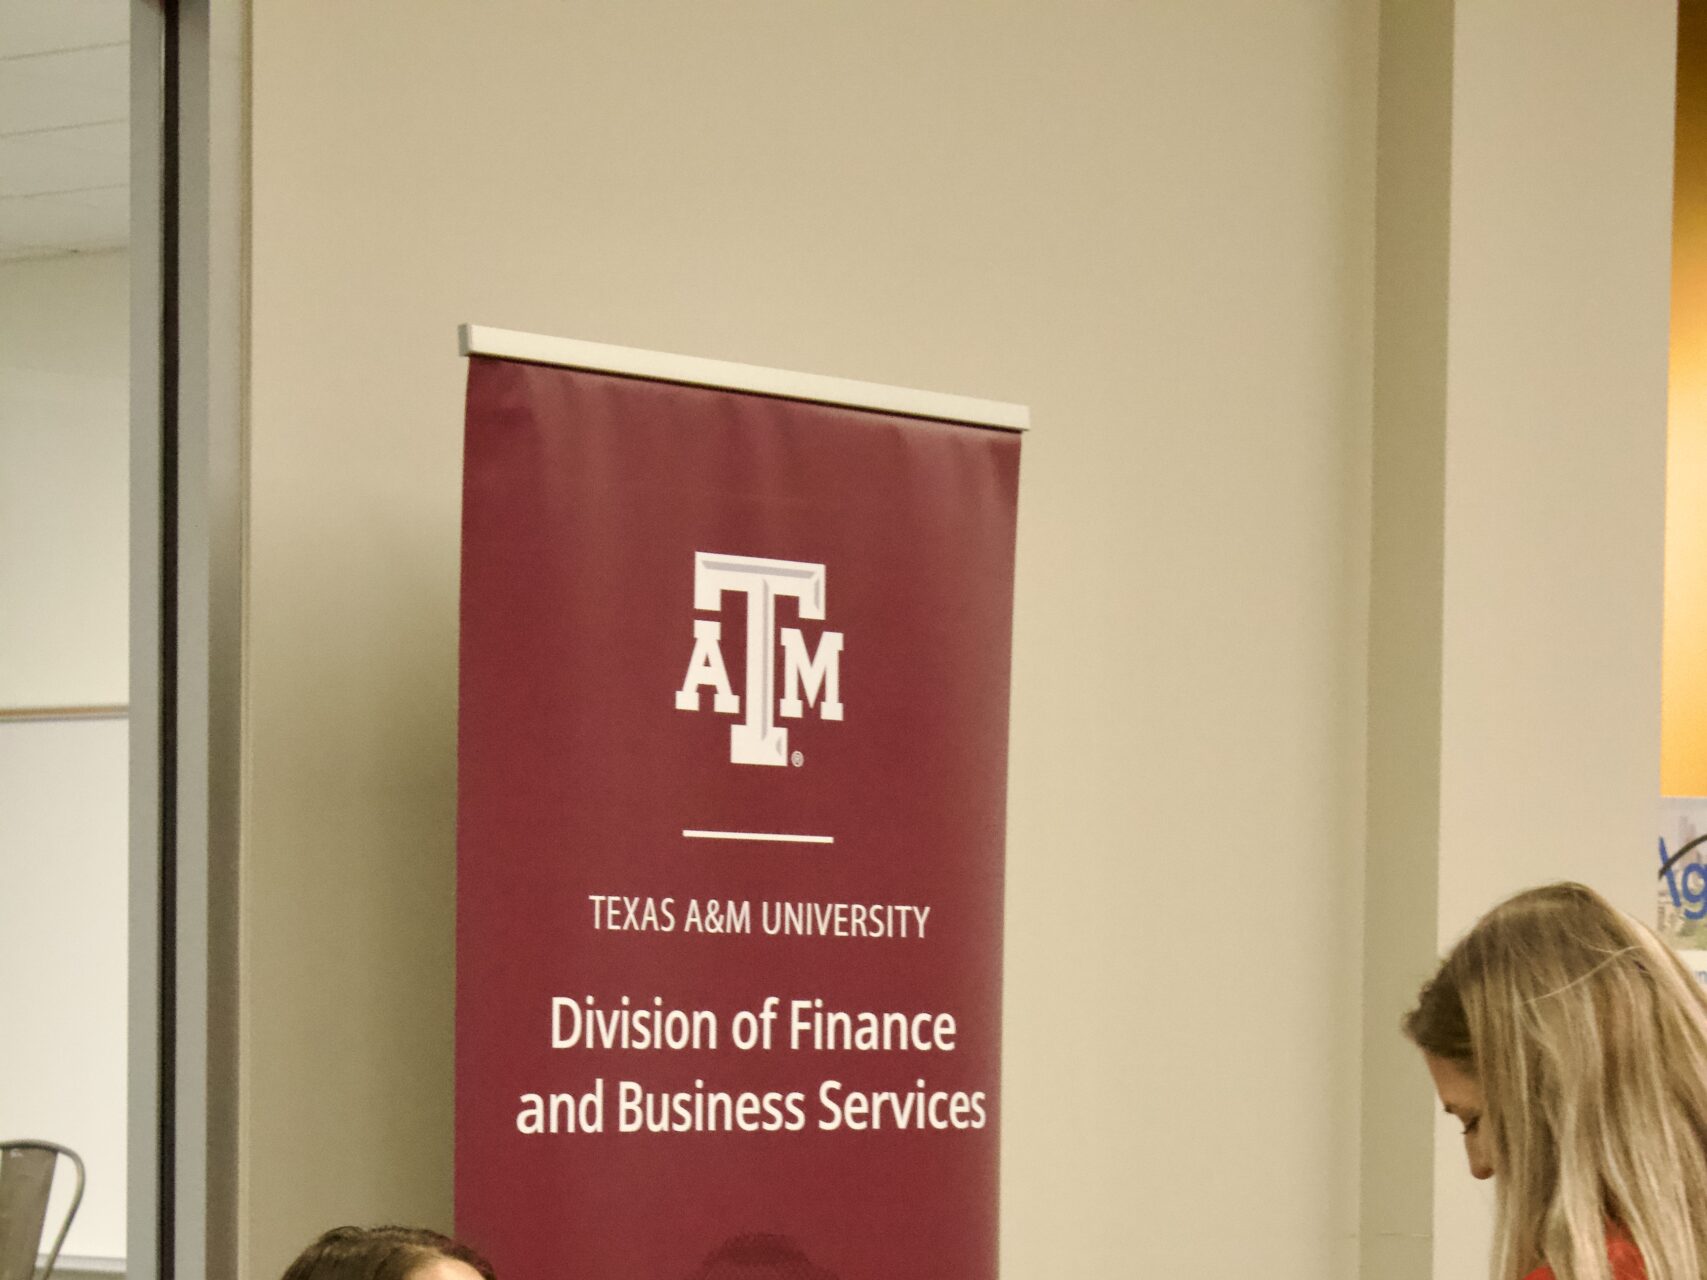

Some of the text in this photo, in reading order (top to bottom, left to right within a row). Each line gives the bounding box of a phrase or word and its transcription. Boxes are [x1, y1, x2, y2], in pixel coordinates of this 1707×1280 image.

[589, 895, 931, 938] TEXAS A&M UNIVERSITY
[551, 996, 957, 1051] Division of Finance
[516, 1078, 987, 1134] and Business Services
